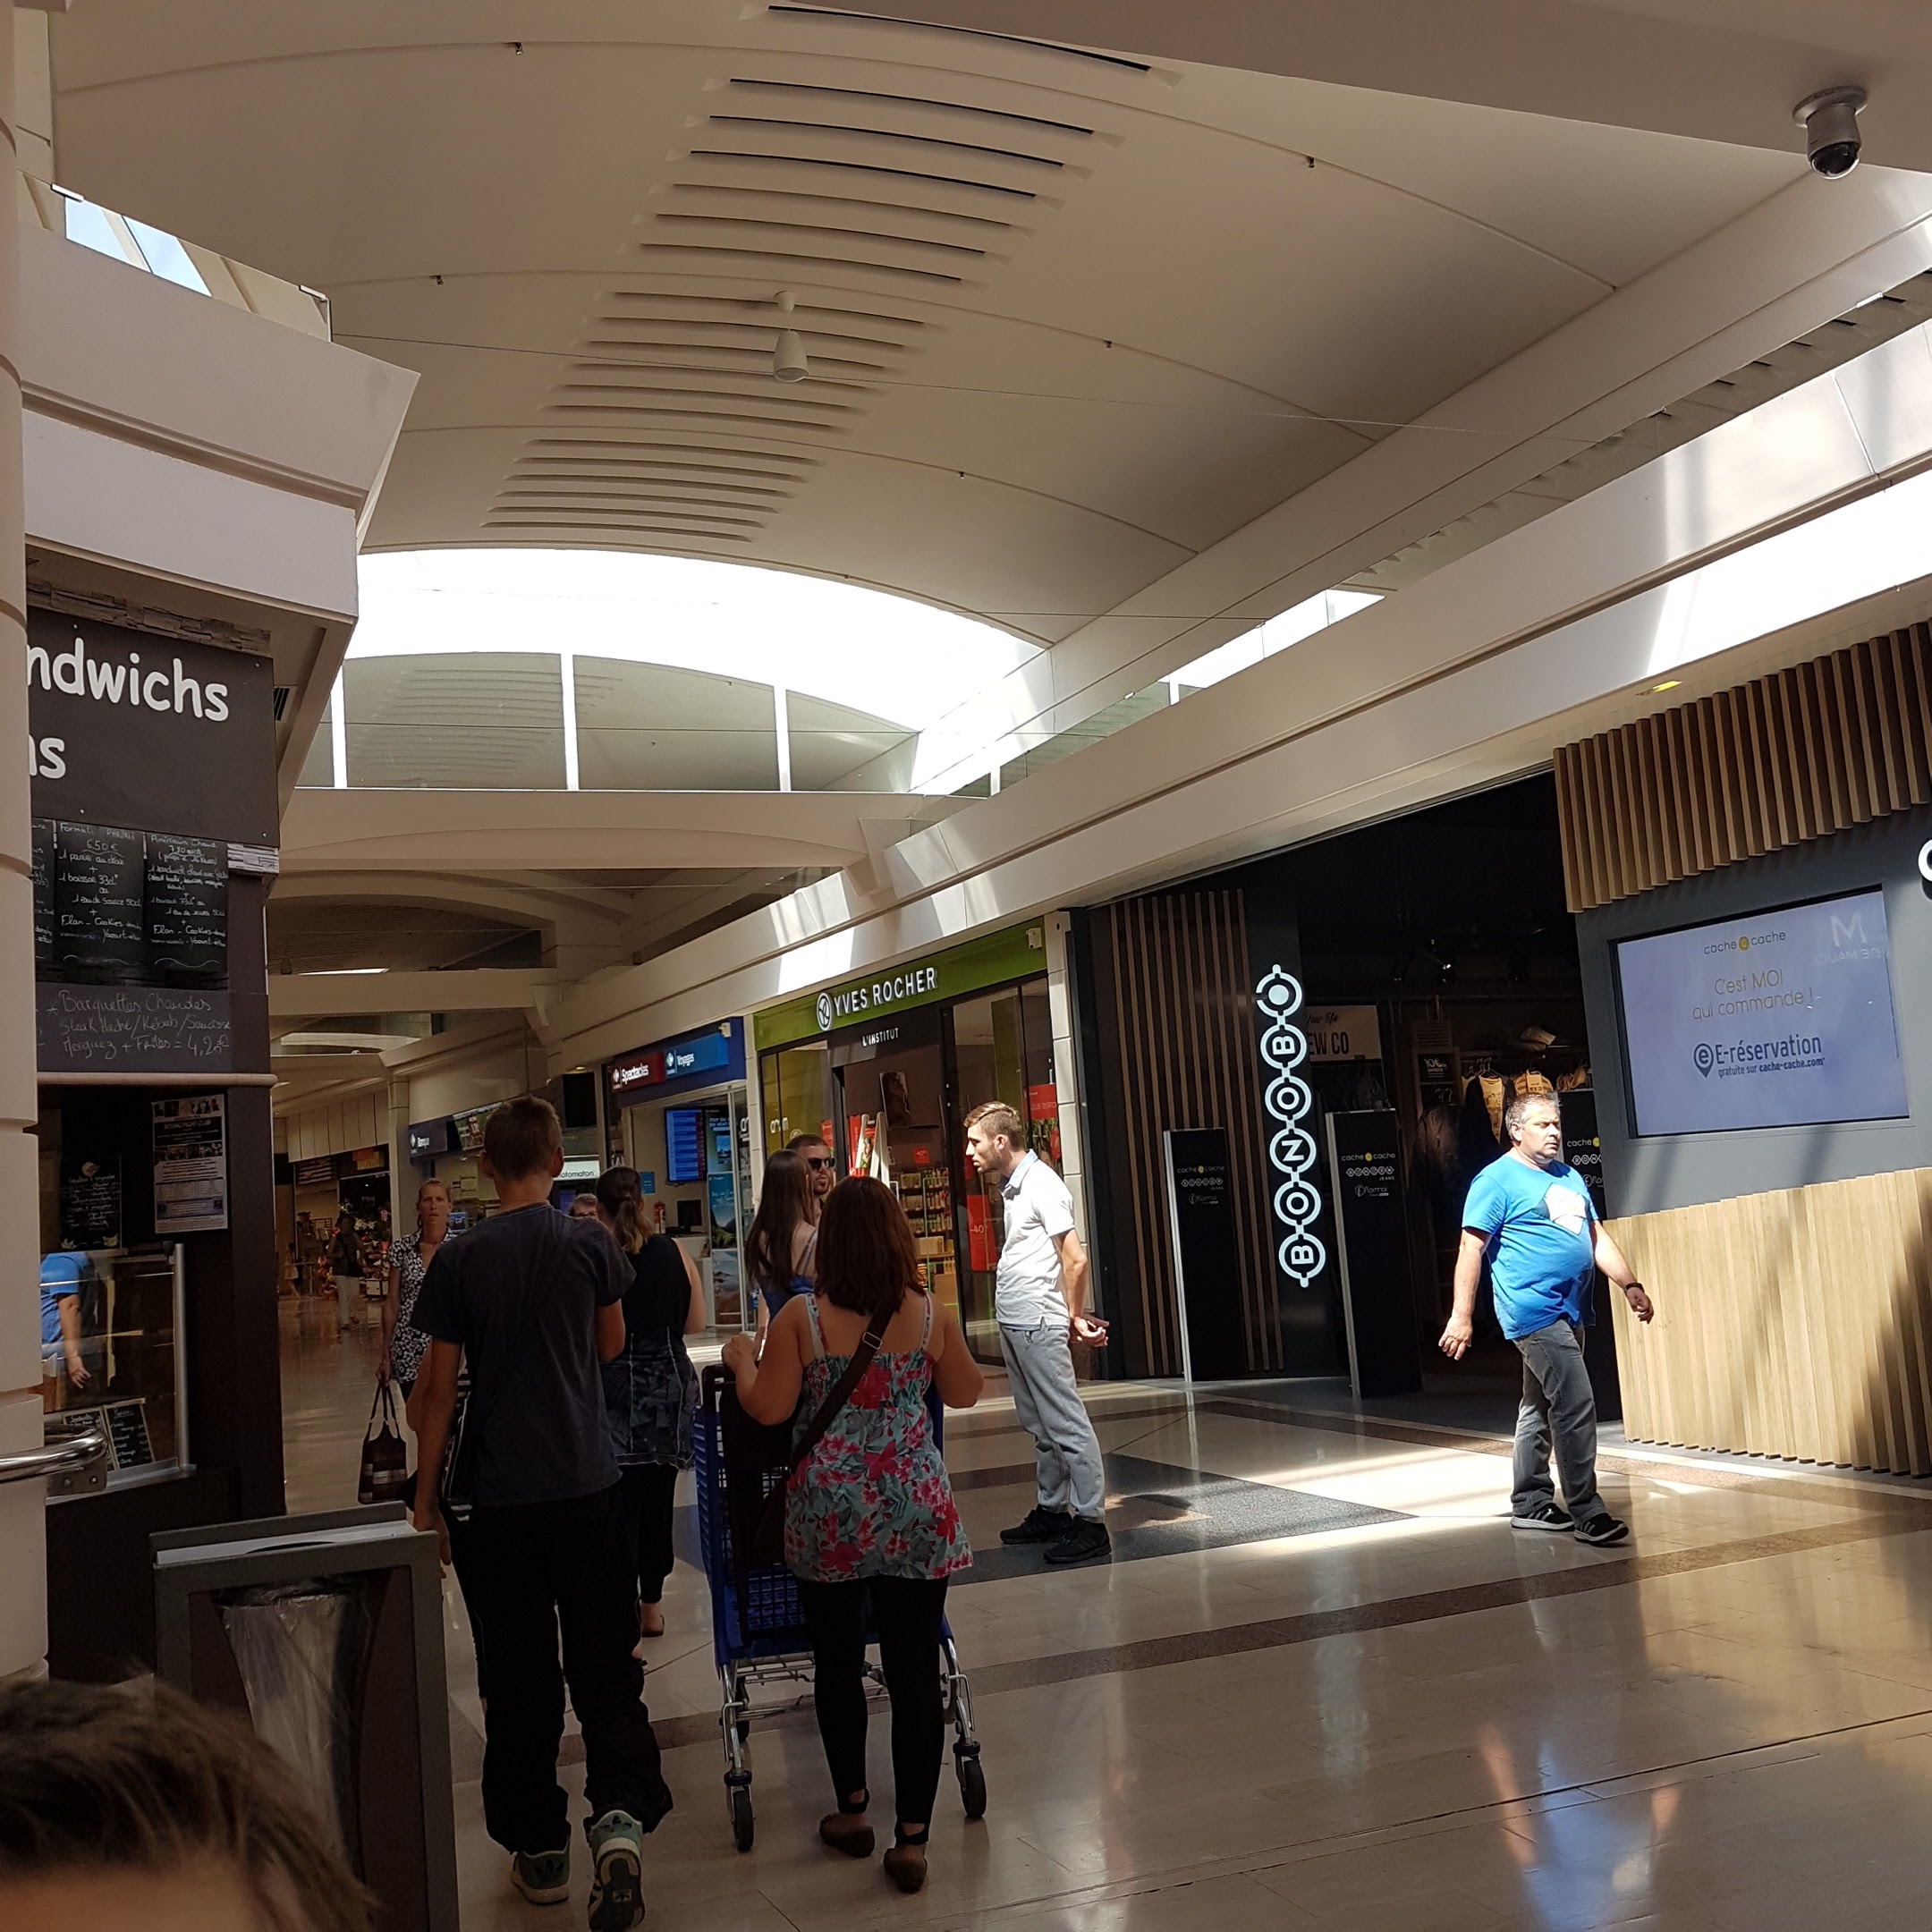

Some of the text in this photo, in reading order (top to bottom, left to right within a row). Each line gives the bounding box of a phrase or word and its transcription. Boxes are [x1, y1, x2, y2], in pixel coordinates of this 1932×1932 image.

[1704, 931, 1787, 954] cache cache
[834, 967, 937, 1017] YVES ROCHER
[1715, 969, 1784, 995] C'est MOI
[1692, 1002, 1714, 1022] qui
[1718, 990, 1804, 1016] commande
[862, 1028, 899, 1046] L'INSTITUT
[1716, 1034, 1822, 1064] E-réservation
[622, 1063, 649, 1084] Spectacles
[1718, 1065, 1745, 1079] gratuite
[1746, 1065, 1758, 1075] sur
[1572, 1154, 1601, 1165] BON
[561, 1170, 593, 1178] otomaton
